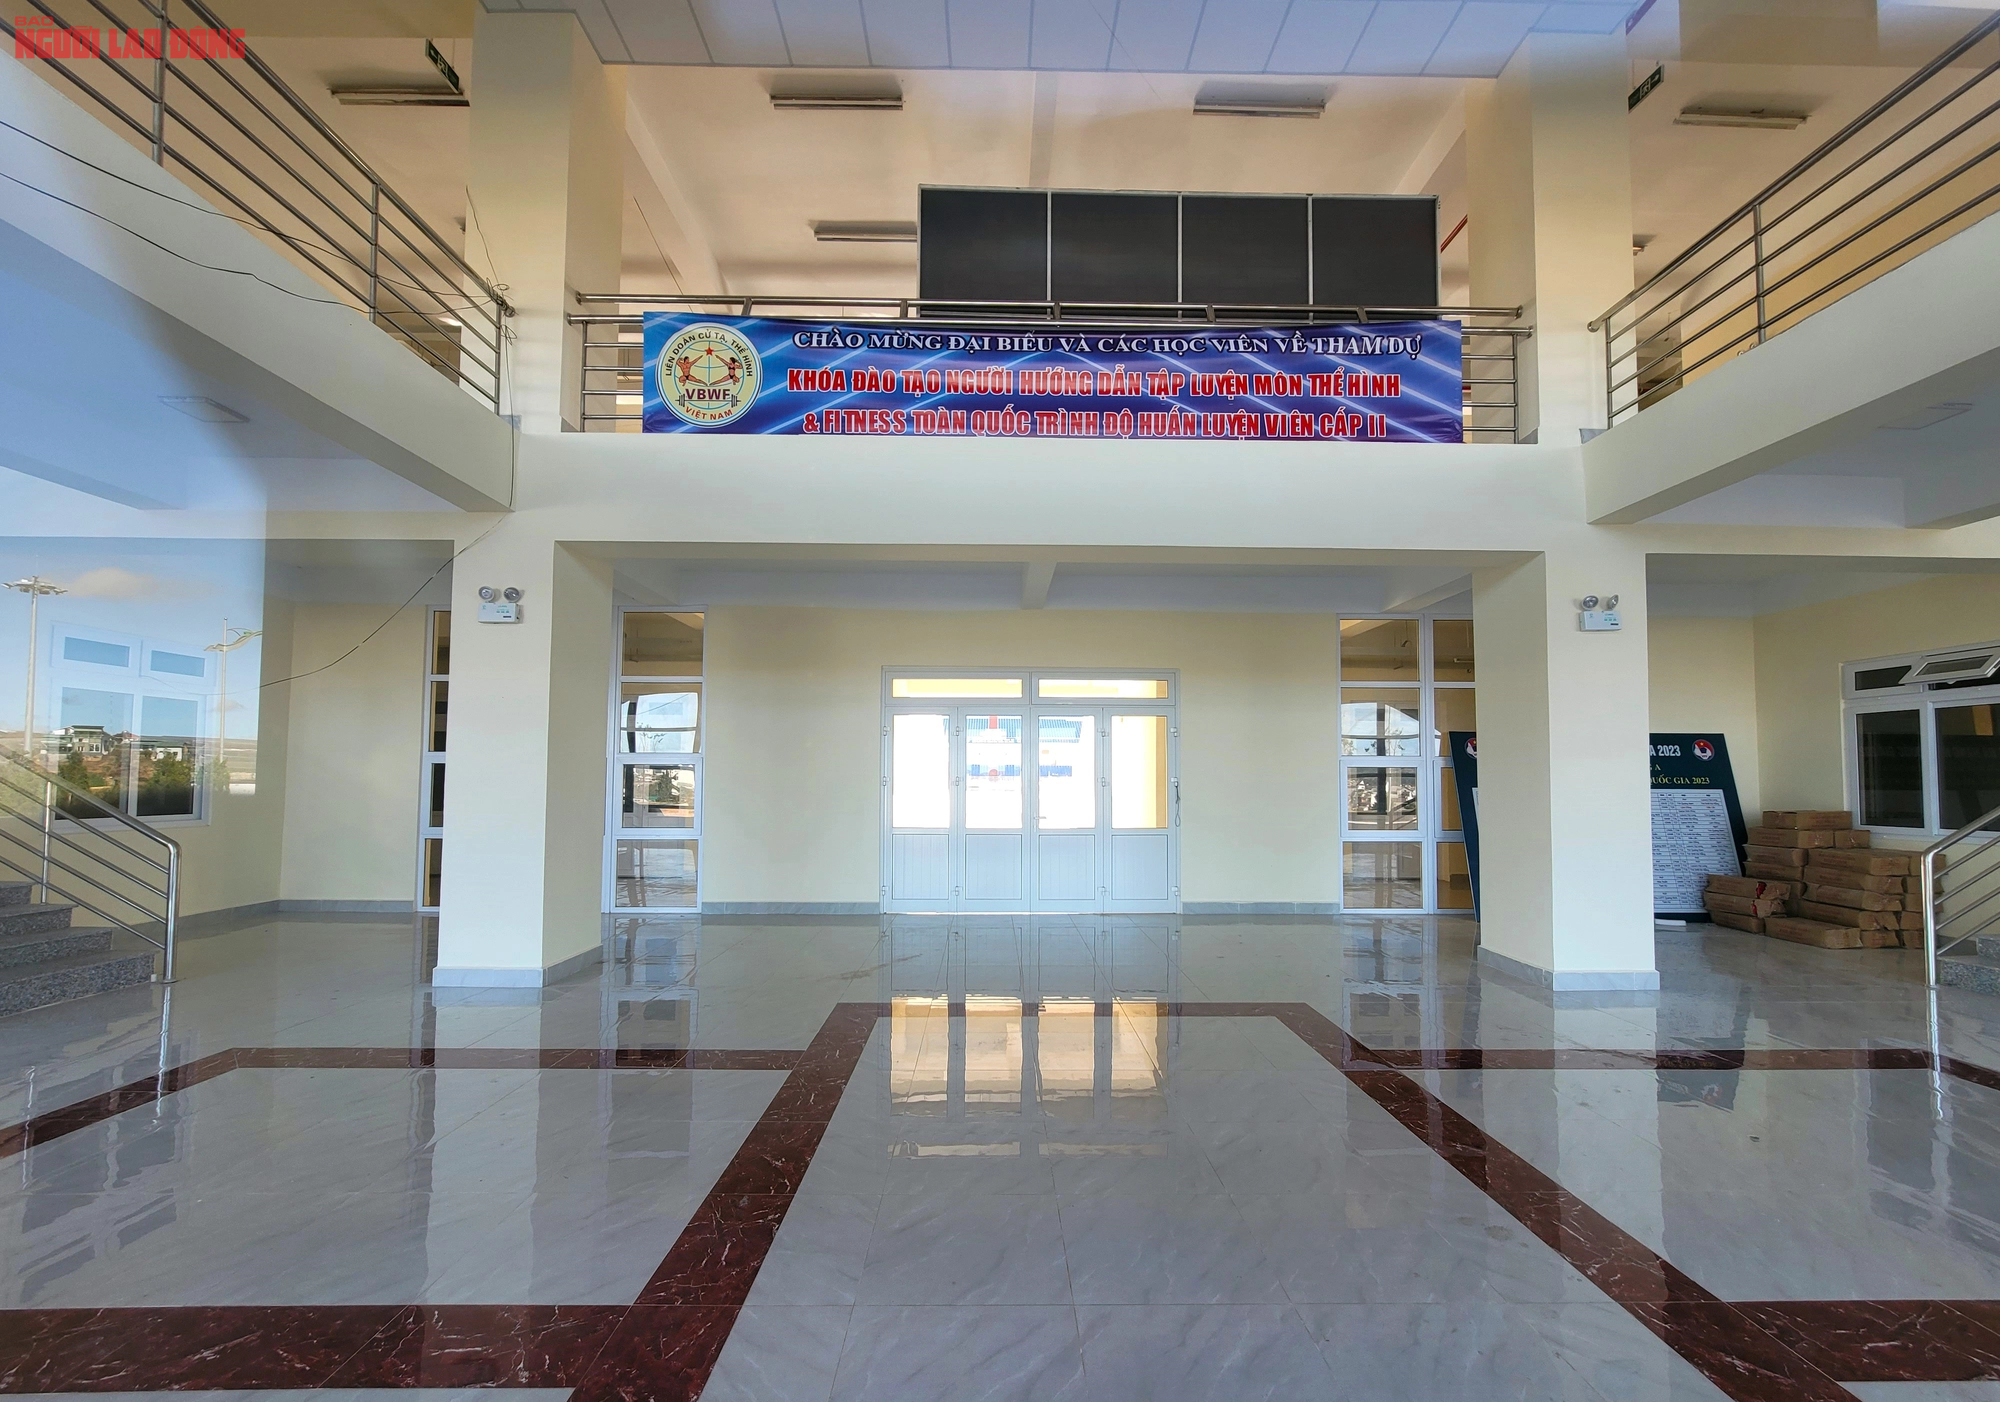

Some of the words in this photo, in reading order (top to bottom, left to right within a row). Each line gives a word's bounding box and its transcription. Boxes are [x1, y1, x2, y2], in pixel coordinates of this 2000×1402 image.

[665, 356, 676, 376] LIÊN
[673, 334, 696, 355] ĐOÀN
[698, 329, 712, 339] CỬ
[742, 355, 753, 376] HÌNH
[793, 328, 864, 348] CHÀO
[868, 330, 942, 349] MỪNG
[948, 336, 991, 354] ĐẠI
[1059, 333, 1091, 352] VÀ
[1098, 333, 1147, 352] CÁC
[1153, 337, 1206, 356] HỌC
[1211, 334, 1268, 352] VIÊN
[1275, 331, 1307, 353] VỀ
[1312, 336, 1384, 355] THAM
[1388, 334, 1422, 359] DỰ
[788, 366, 847, 392] KHÓA
[851, 366, 896, 393] ĐÀO
[901, 369, 941, 397] TẠO
[946, 365, 1013, 394] NGƯỜI
[1019, 365, 1093, 396] HƯỚNG
[1097, 364, 1142, 396] DẪN
[1146, 368, 1185, 399] TẬP
[1190, 369, 1249, 400] LUYỆN
[1253, 370, 1303, 397] MÔN
[1307, 366, 1344, 397] THỂ
[1346, 371, 1401, 398] HÌNH
[685, 388, 731, 400] VBWF
[685, 406, 707, 419] VIỆT
[710, 409, 733, 420] NAM
[803, 412, 820, 433] &
[823, 409, 906, 434] FITNESS
[911, 406, 967, 434] TOÀN
[971, 404, 1031, 437] QUỐC
[1034, 408, 1099, 436] TRÌNH
[1103, 408, 1133, 439] ĐỘ
[1138, 405, 1197, 437] HUẤN
[1201, 409, 1260, 439] LUYỆN
[1264, 409, 1315, 438] VIÊN
[1319, 406, 1363, 438] CẤP
[1368, 413, 1387, 438] II
[1657, 744, 1682, 757] 2023
[1650, 774, 1672, 785] UỐC
[1673, 776, 1690, 785] GIA
[1692, 776, 1710, 785] 2023
